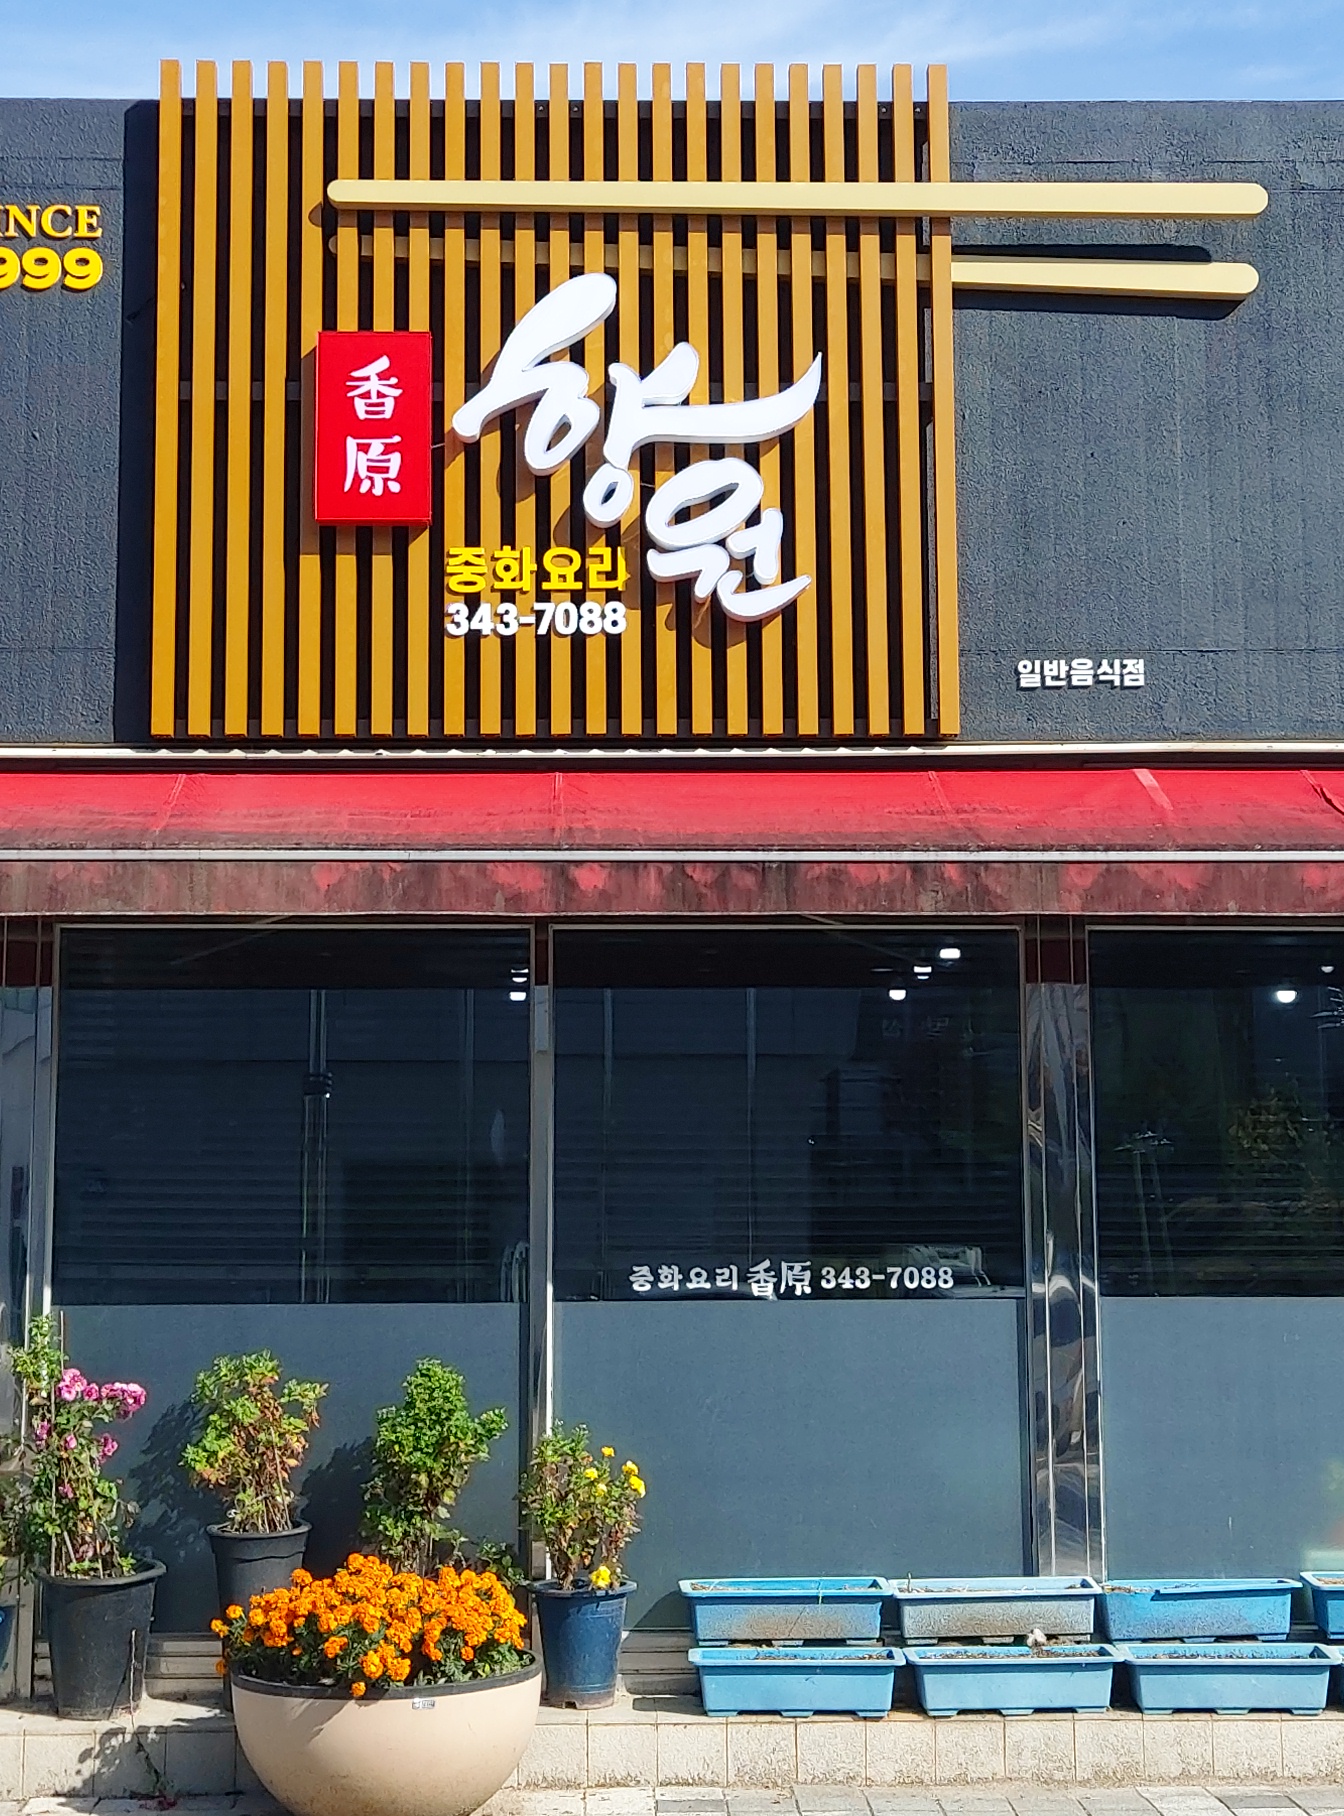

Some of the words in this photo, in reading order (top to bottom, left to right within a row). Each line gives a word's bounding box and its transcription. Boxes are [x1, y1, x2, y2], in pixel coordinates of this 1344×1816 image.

[343, 354, 404, 497] 香原
[452, 272, 823, 622] 향원
[446, 546, 628, 592] 중화요리
[446, 601, 627, 635] 343-7088
[1017, 658, 1145, 687] 일반음식점
[628, 1265, 739, 1292] 중화요리
[746, 1258, 812, 1297] 香原
[820, 1266, 955, 1290] 343-7088
